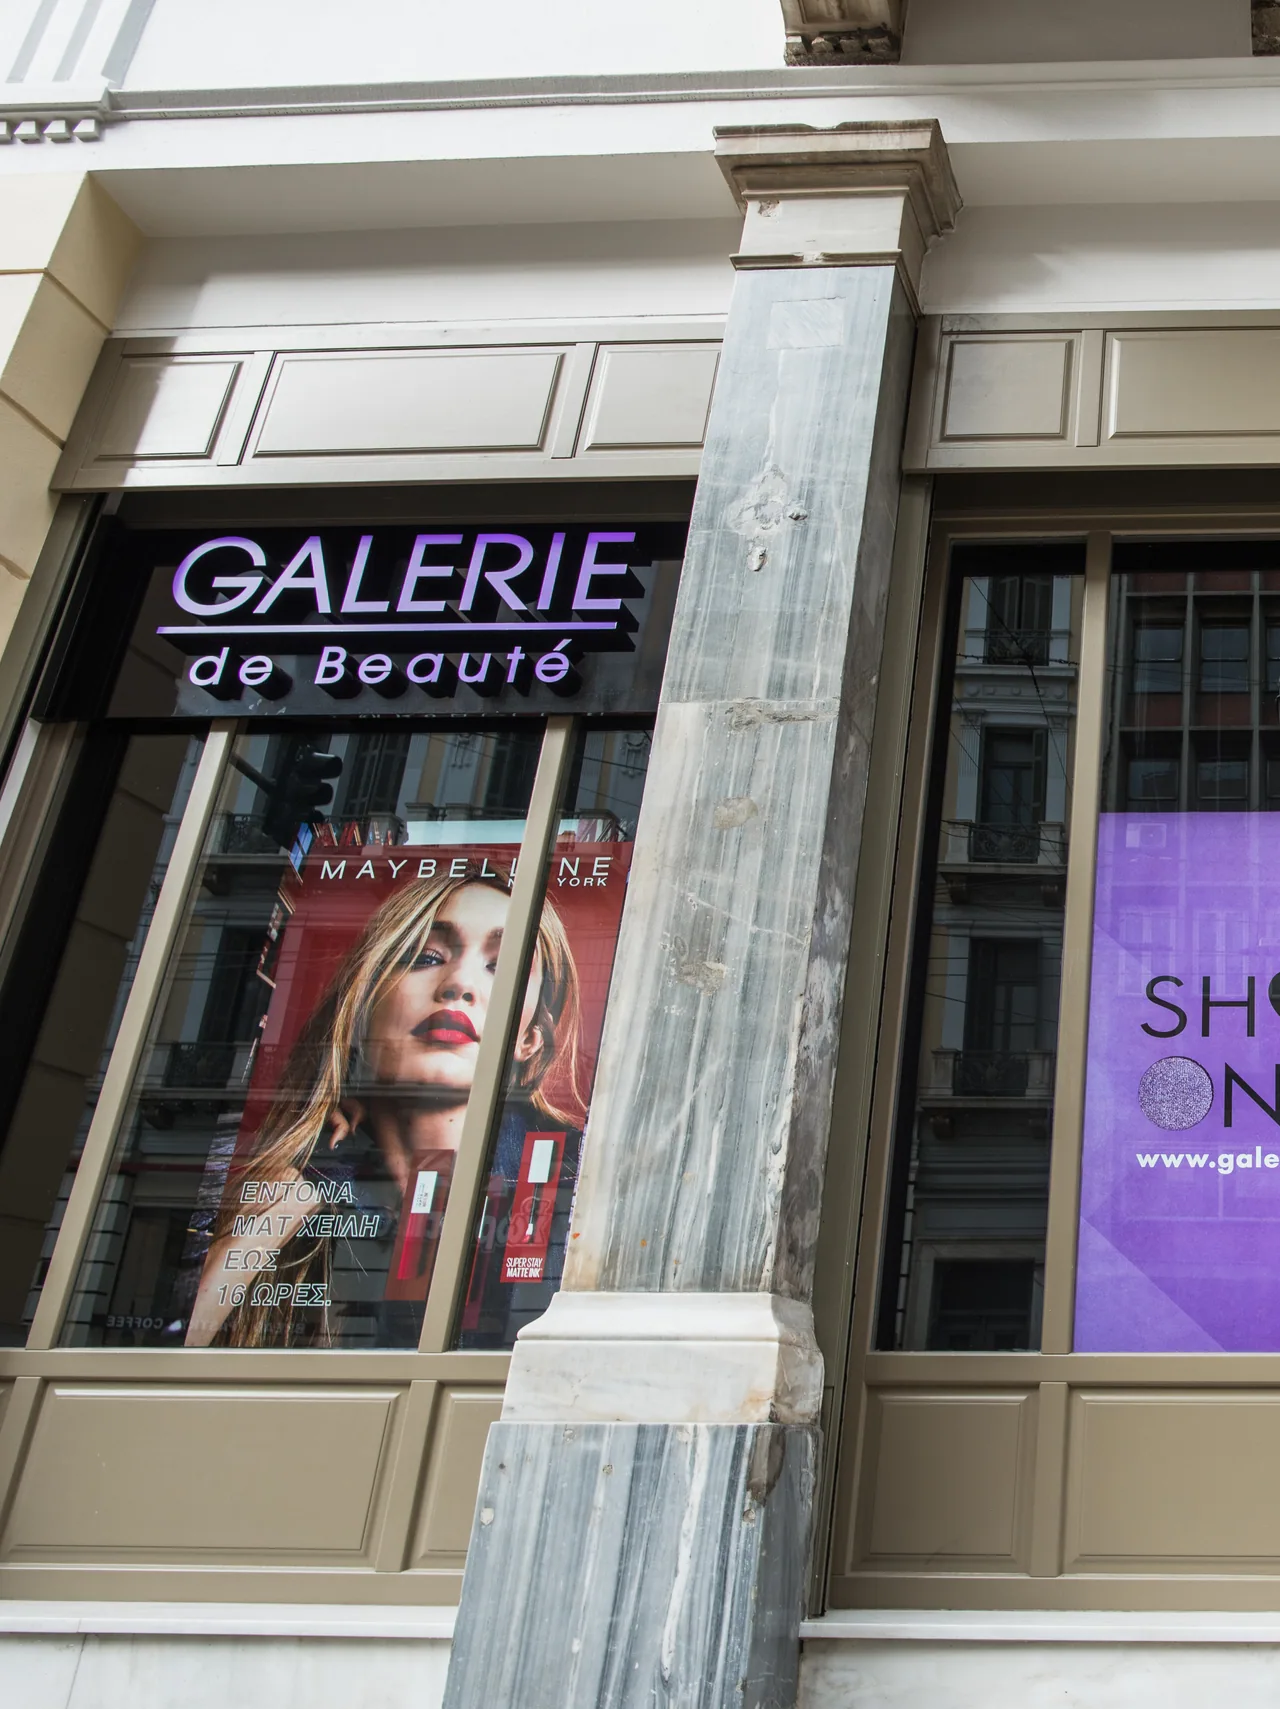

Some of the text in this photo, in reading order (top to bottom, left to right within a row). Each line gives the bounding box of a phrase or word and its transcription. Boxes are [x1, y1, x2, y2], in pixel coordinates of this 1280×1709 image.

[172, 531, 637, 617] GALERIE
[188, 638, 574, 687] de Beauté
[320, 857, 612, 880] MAYBELLNE
[557, 877, 608, 887] YORK
[223, 1249, 280, 1271] ΕΩΣ
[506, 1257, 543, 1267] SUPER STAY
[506, 1268, 529, 1278] MATTE
[218, 1283, 246, 1306] 16
